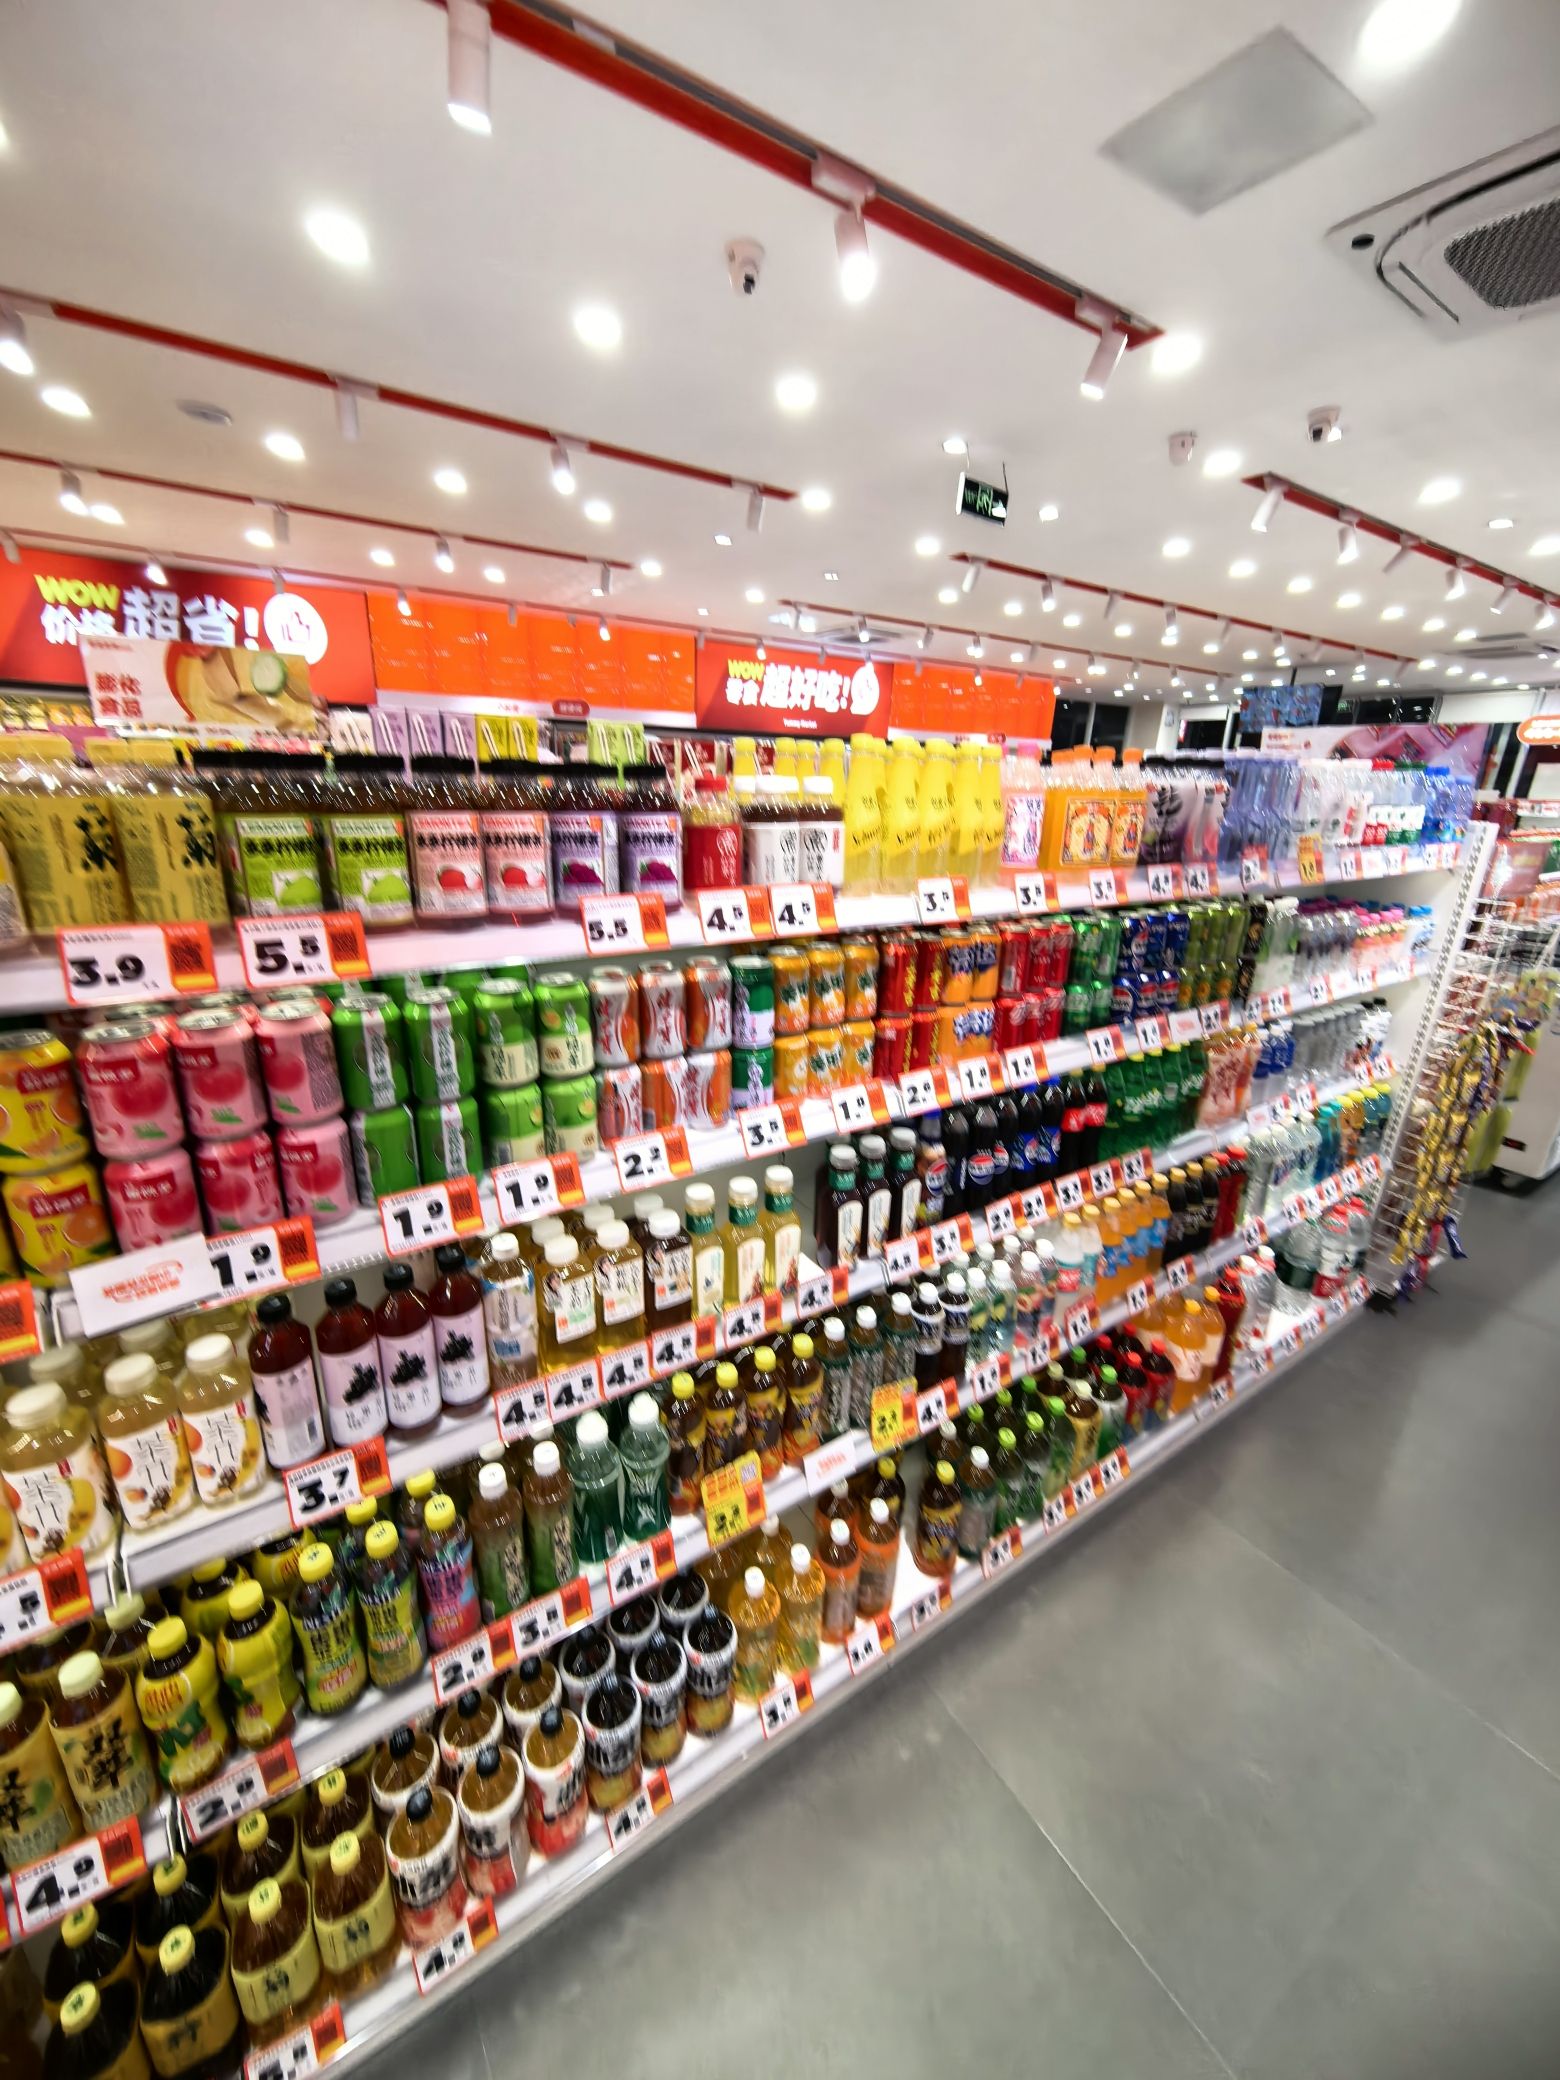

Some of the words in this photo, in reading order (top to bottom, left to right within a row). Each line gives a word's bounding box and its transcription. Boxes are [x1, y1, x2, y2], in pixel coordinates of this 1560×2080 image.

[35, 575, 120, 609] WOW
[728, 659, 765, 681] WOW
[587, 919, 628, 942] 5.5
[70, 953, 145, 988] 3.9
[254, 934, 322, 976] 5.5
[505, 1173, 549, 1210] 1.9
[392, 1200, 444, 1239] 1.9
[209, 1243, 272, 1289] 1.9
[297, 1466, 350, 1515] 3.7
[24, 1854, 96, 1916] 4.9
